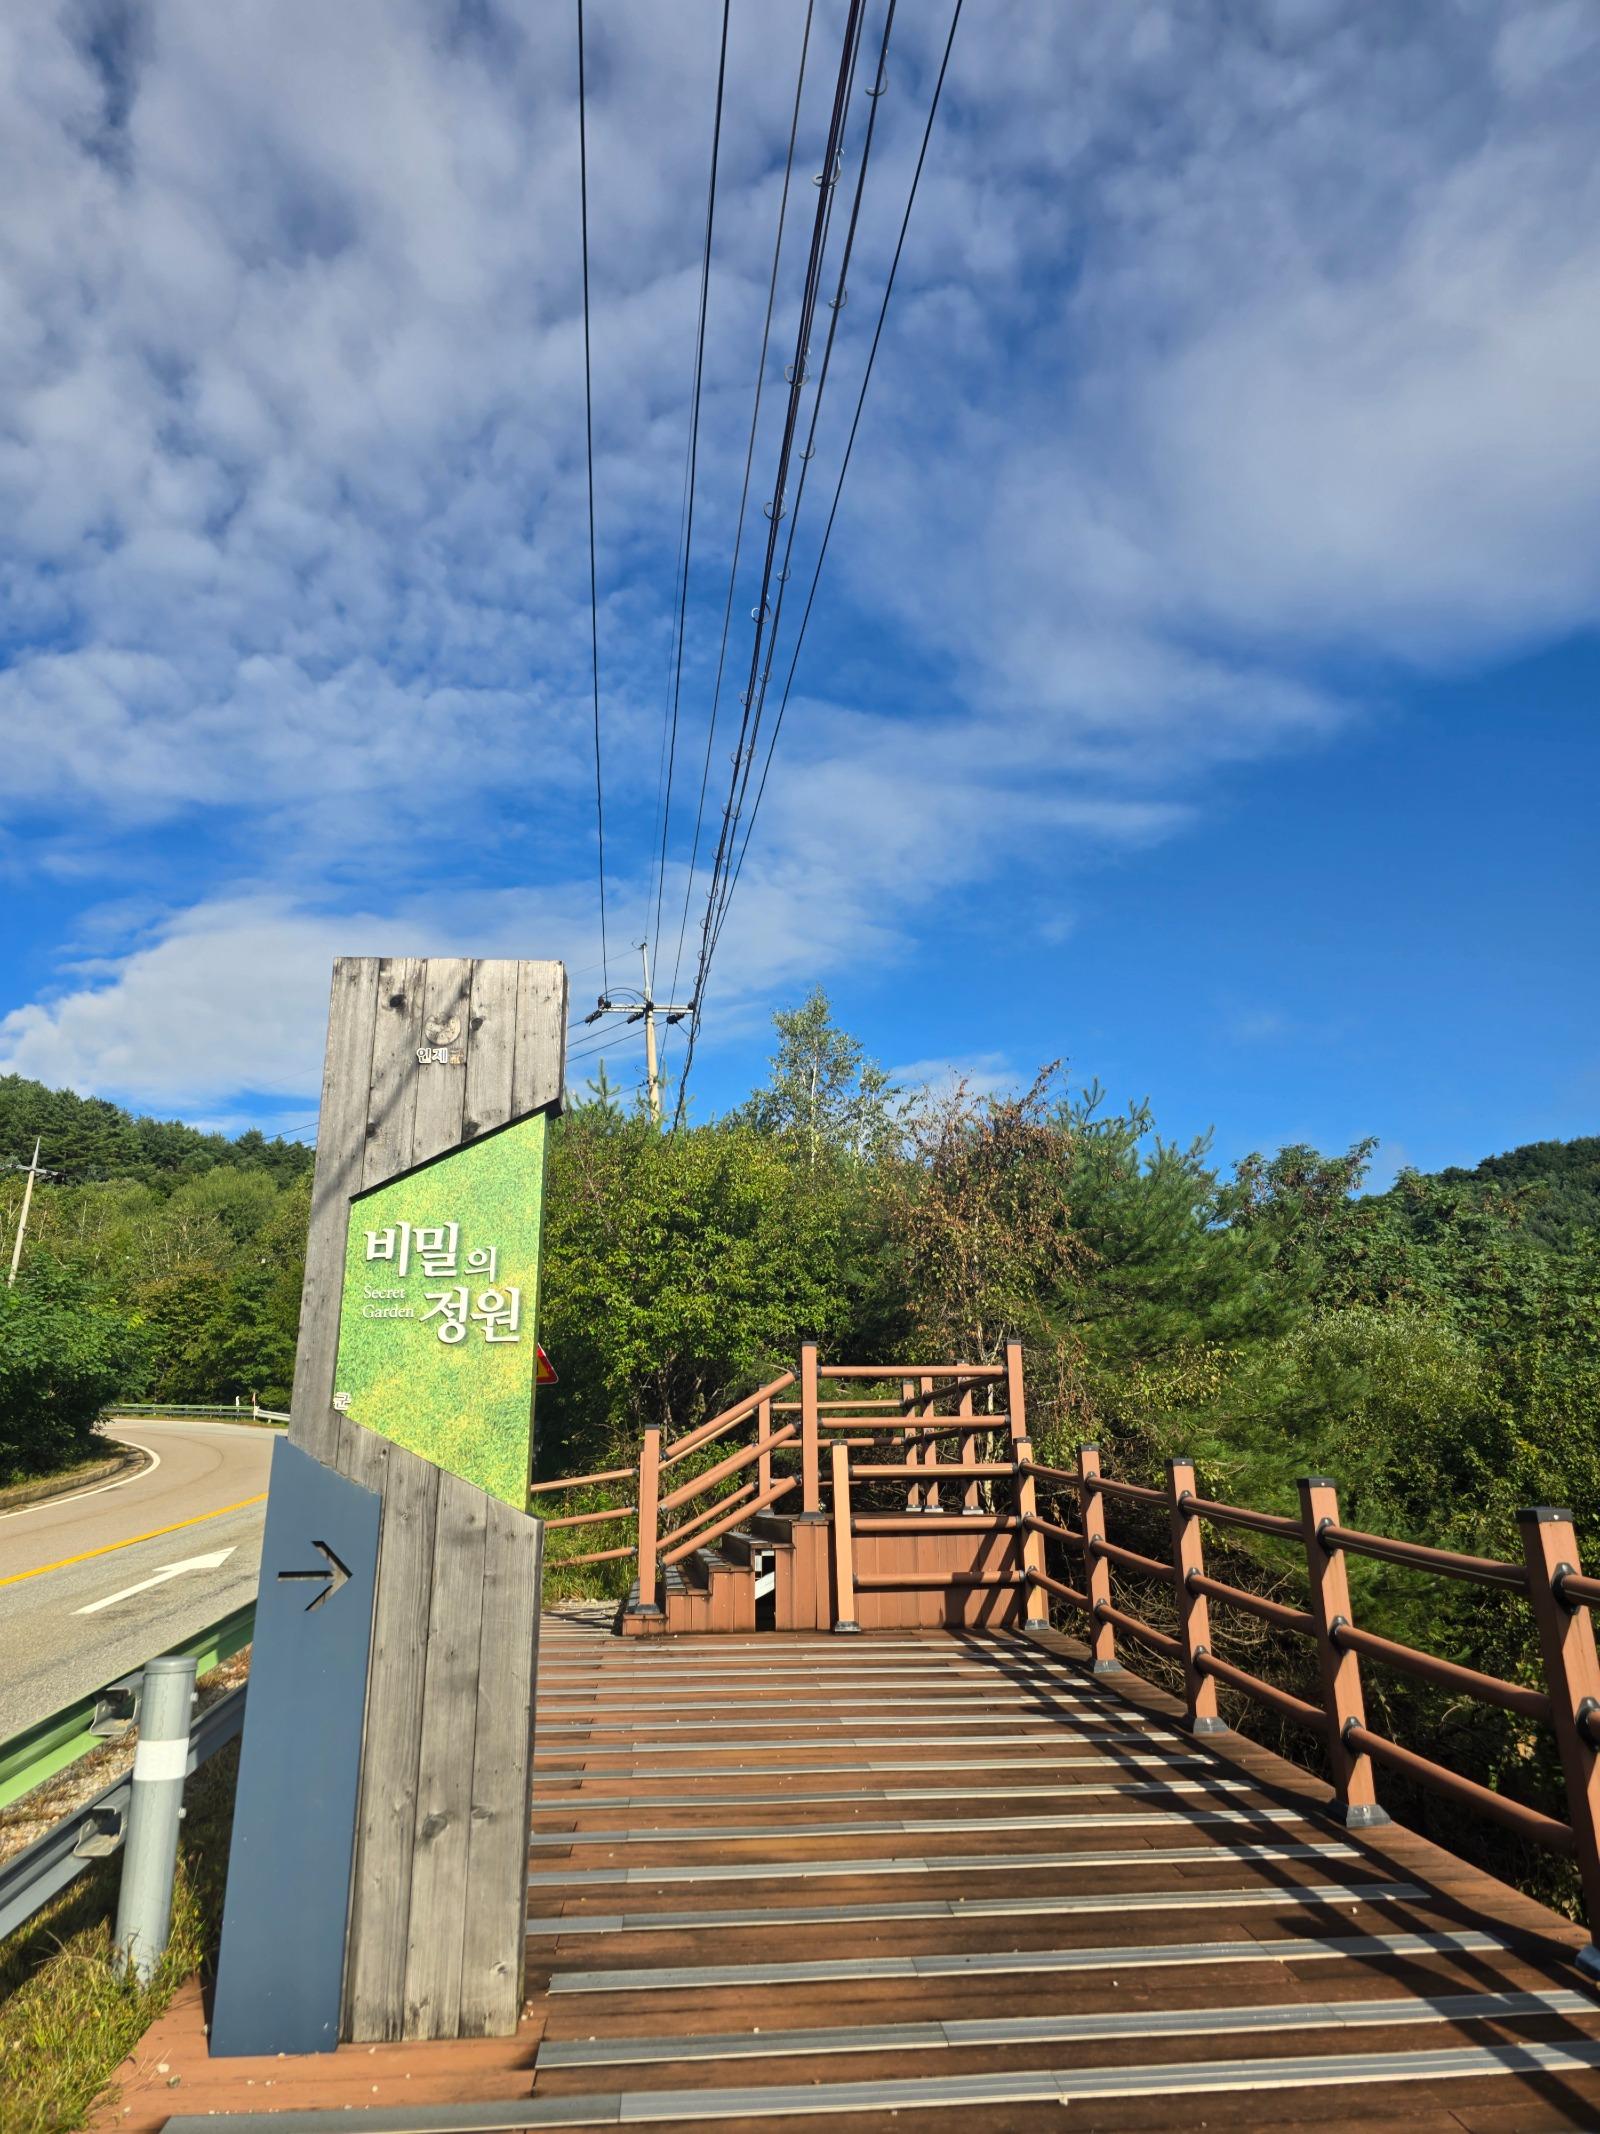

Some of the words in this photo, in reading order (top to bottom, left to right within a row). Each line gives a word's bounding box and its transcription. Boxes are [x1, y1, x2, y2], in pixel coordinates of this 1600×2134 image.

[364, 1221, 497, 1283] 비밀의
[363, 1285, 406, 1299] Secret
[362, 1304, 415, 1319] Garden
[418, 1286, 521, 1344] 정원
